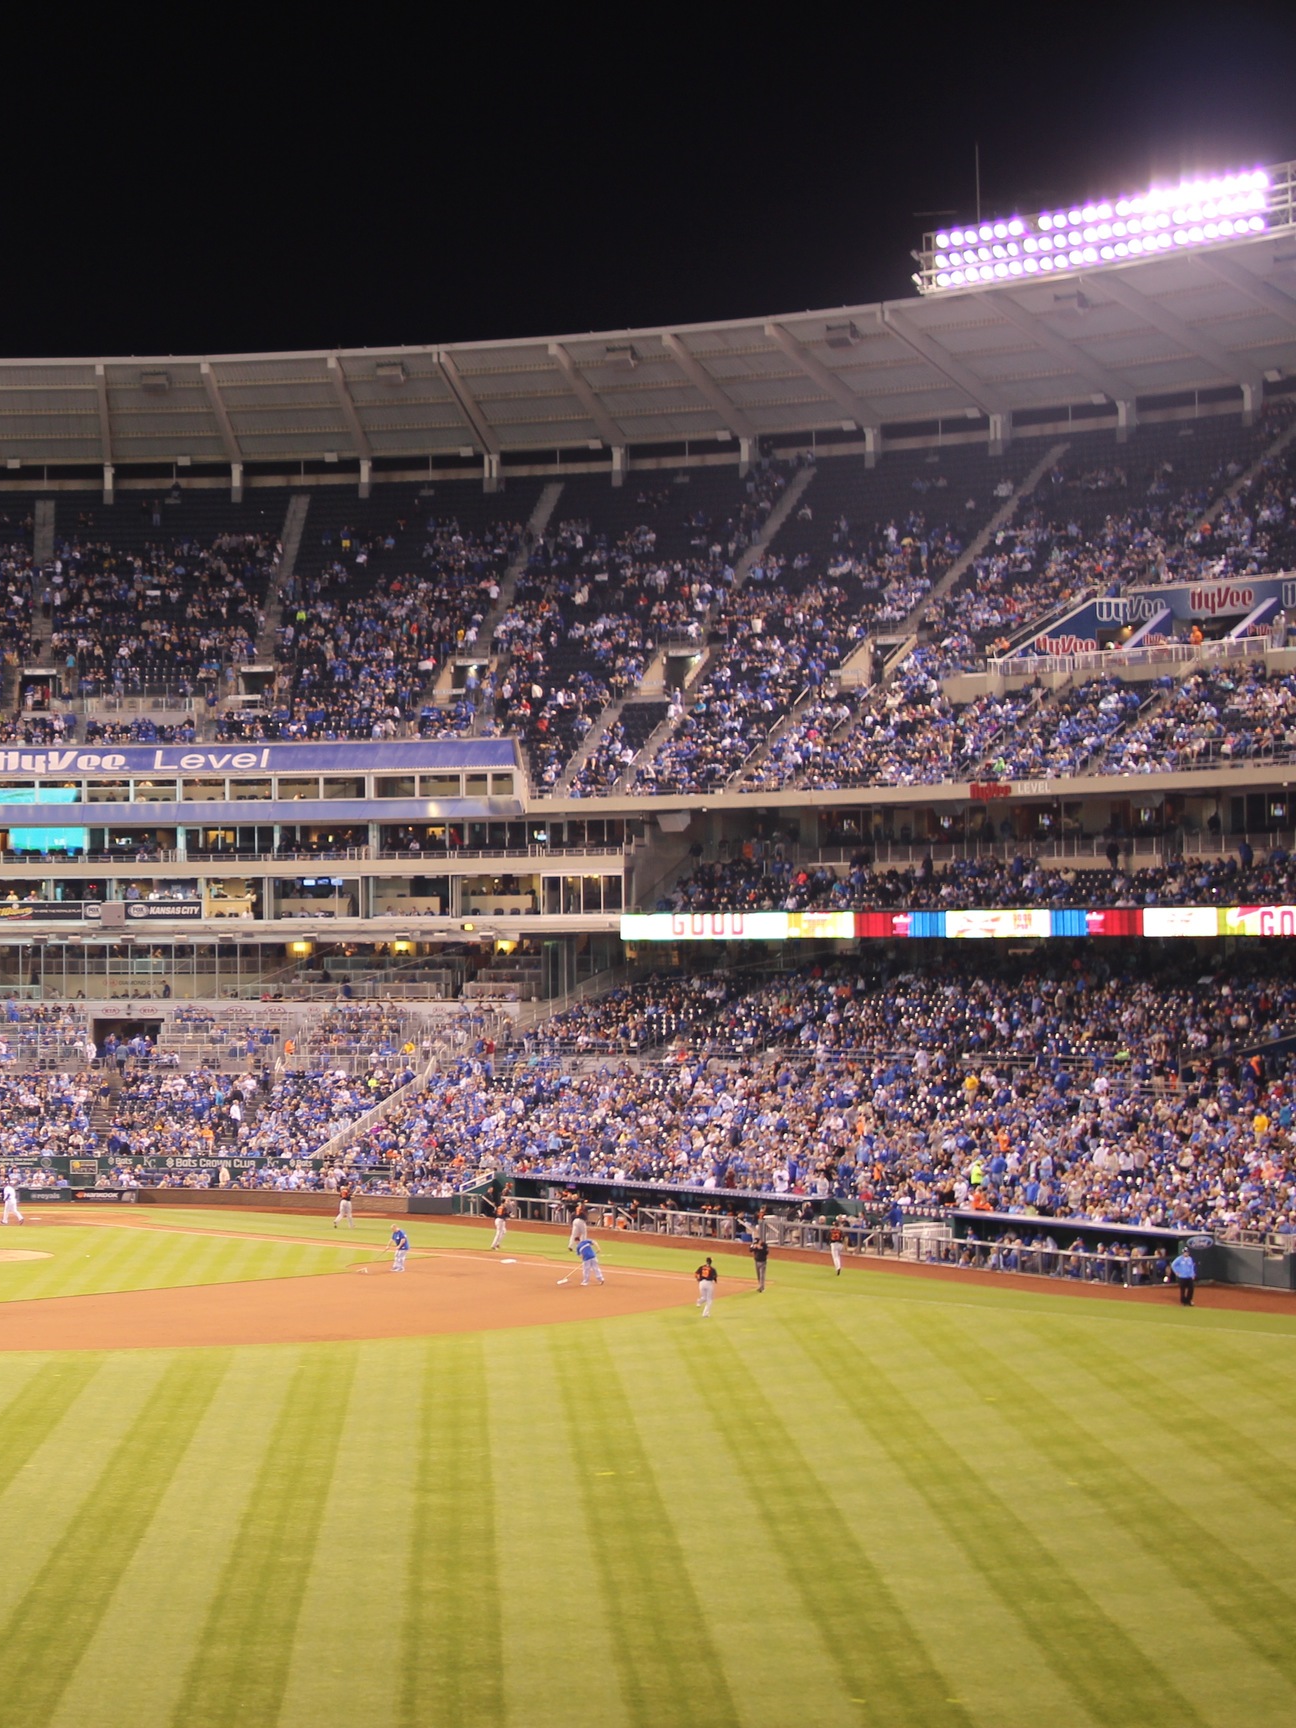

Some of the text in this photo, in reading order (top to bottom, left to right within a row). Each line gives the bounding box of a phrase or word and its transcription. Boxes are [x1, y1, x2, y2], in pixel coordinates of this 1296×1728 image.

[154, 749, 270, 770] Level
[1017, 782, 1051, 794] LEVEL
[149, 906, 181, 915] KANSAS
[181, 906, 200, 915] CITY
